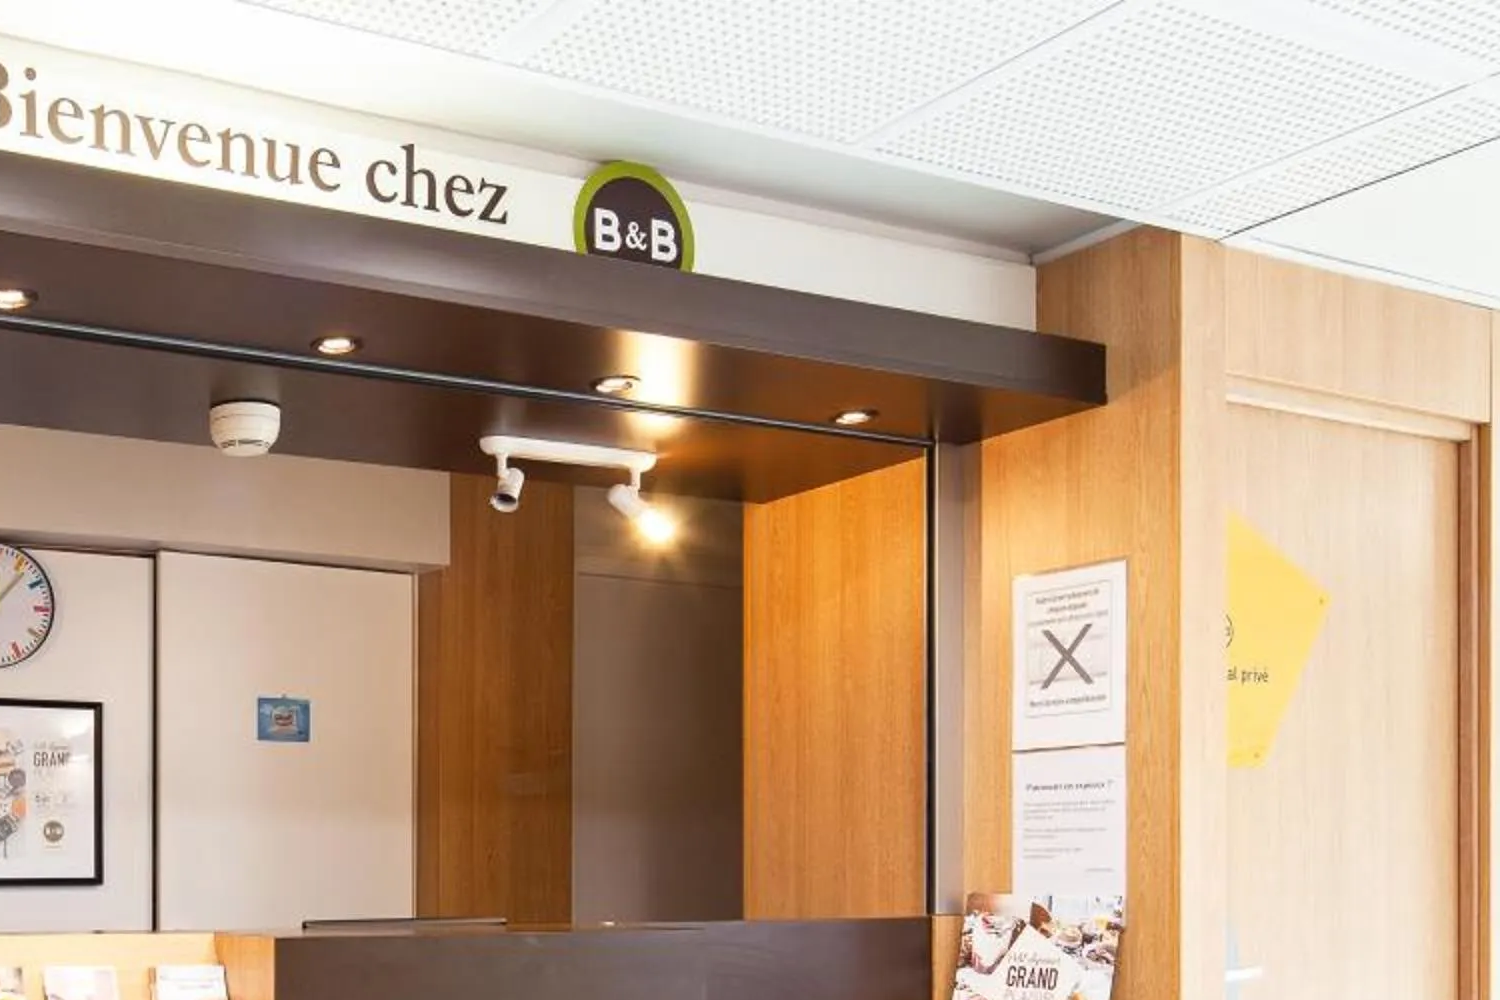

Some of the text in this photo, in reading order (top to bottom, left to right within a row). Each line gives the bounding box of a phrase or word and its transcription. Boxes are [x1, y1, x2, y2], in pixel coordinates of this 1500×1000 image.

[364, 143, 510, 226] chez
[594, 206, 679, 263] B&B
[1241, 666, 1269, 687] privé
[1006, 965, 1059, 991] GRAND
